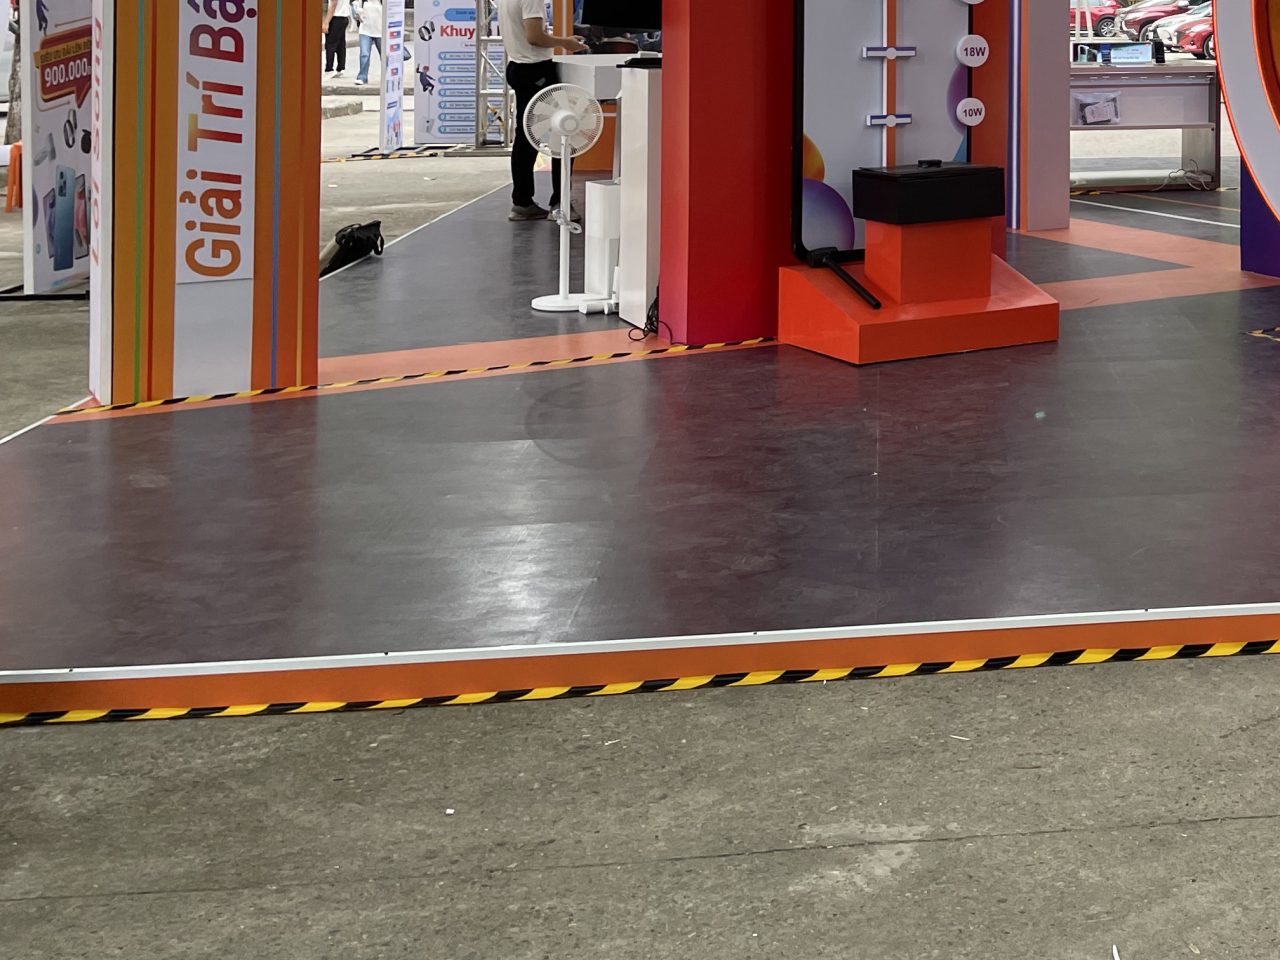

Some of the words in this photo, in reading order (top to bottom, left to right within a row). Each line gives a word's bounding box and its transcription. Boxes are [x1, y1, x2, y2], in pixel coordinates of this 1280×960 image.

[963, 46, 986, 57] 18W
[186, 71, 244, 153] Trí
[963, 107, 983, 118] 10W
[179, 168, 242, 278] Giải
